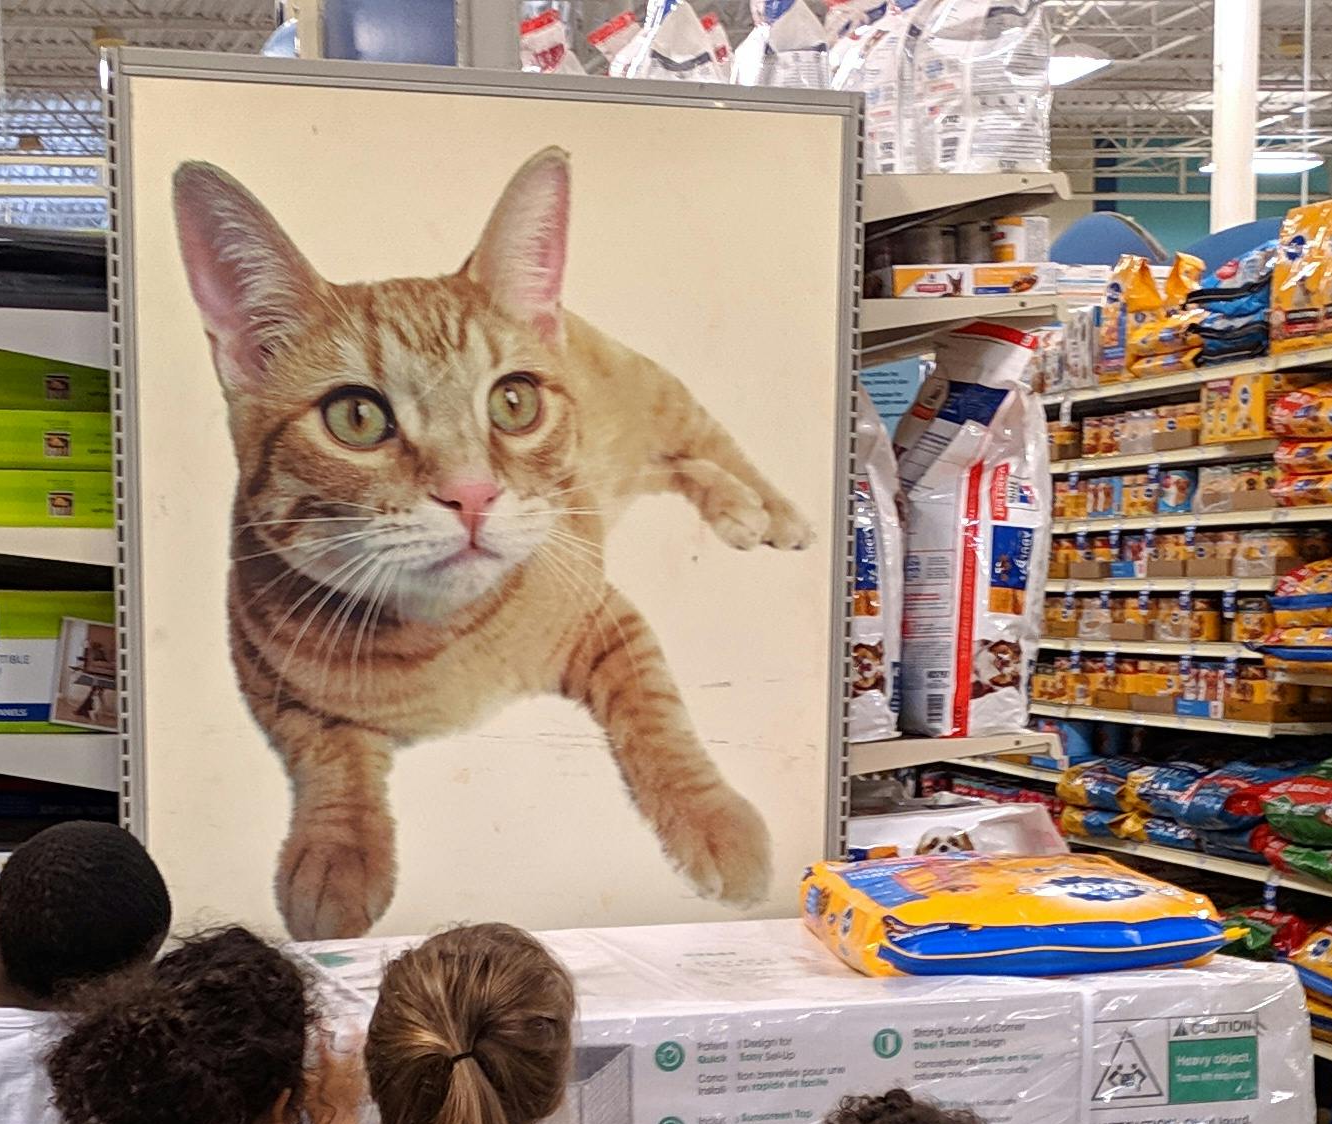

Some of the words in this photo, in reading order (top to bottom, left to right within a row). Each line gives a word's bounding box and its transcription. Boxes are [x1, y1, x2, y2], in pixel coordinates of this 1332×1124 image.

[1191, 1019, 1252, 1035] CAUTION
[743, 1039, 777, 1050] Design
[778, 1037, 792, 1046] for
[1175, 1053, 1211, 1068] Heavy
